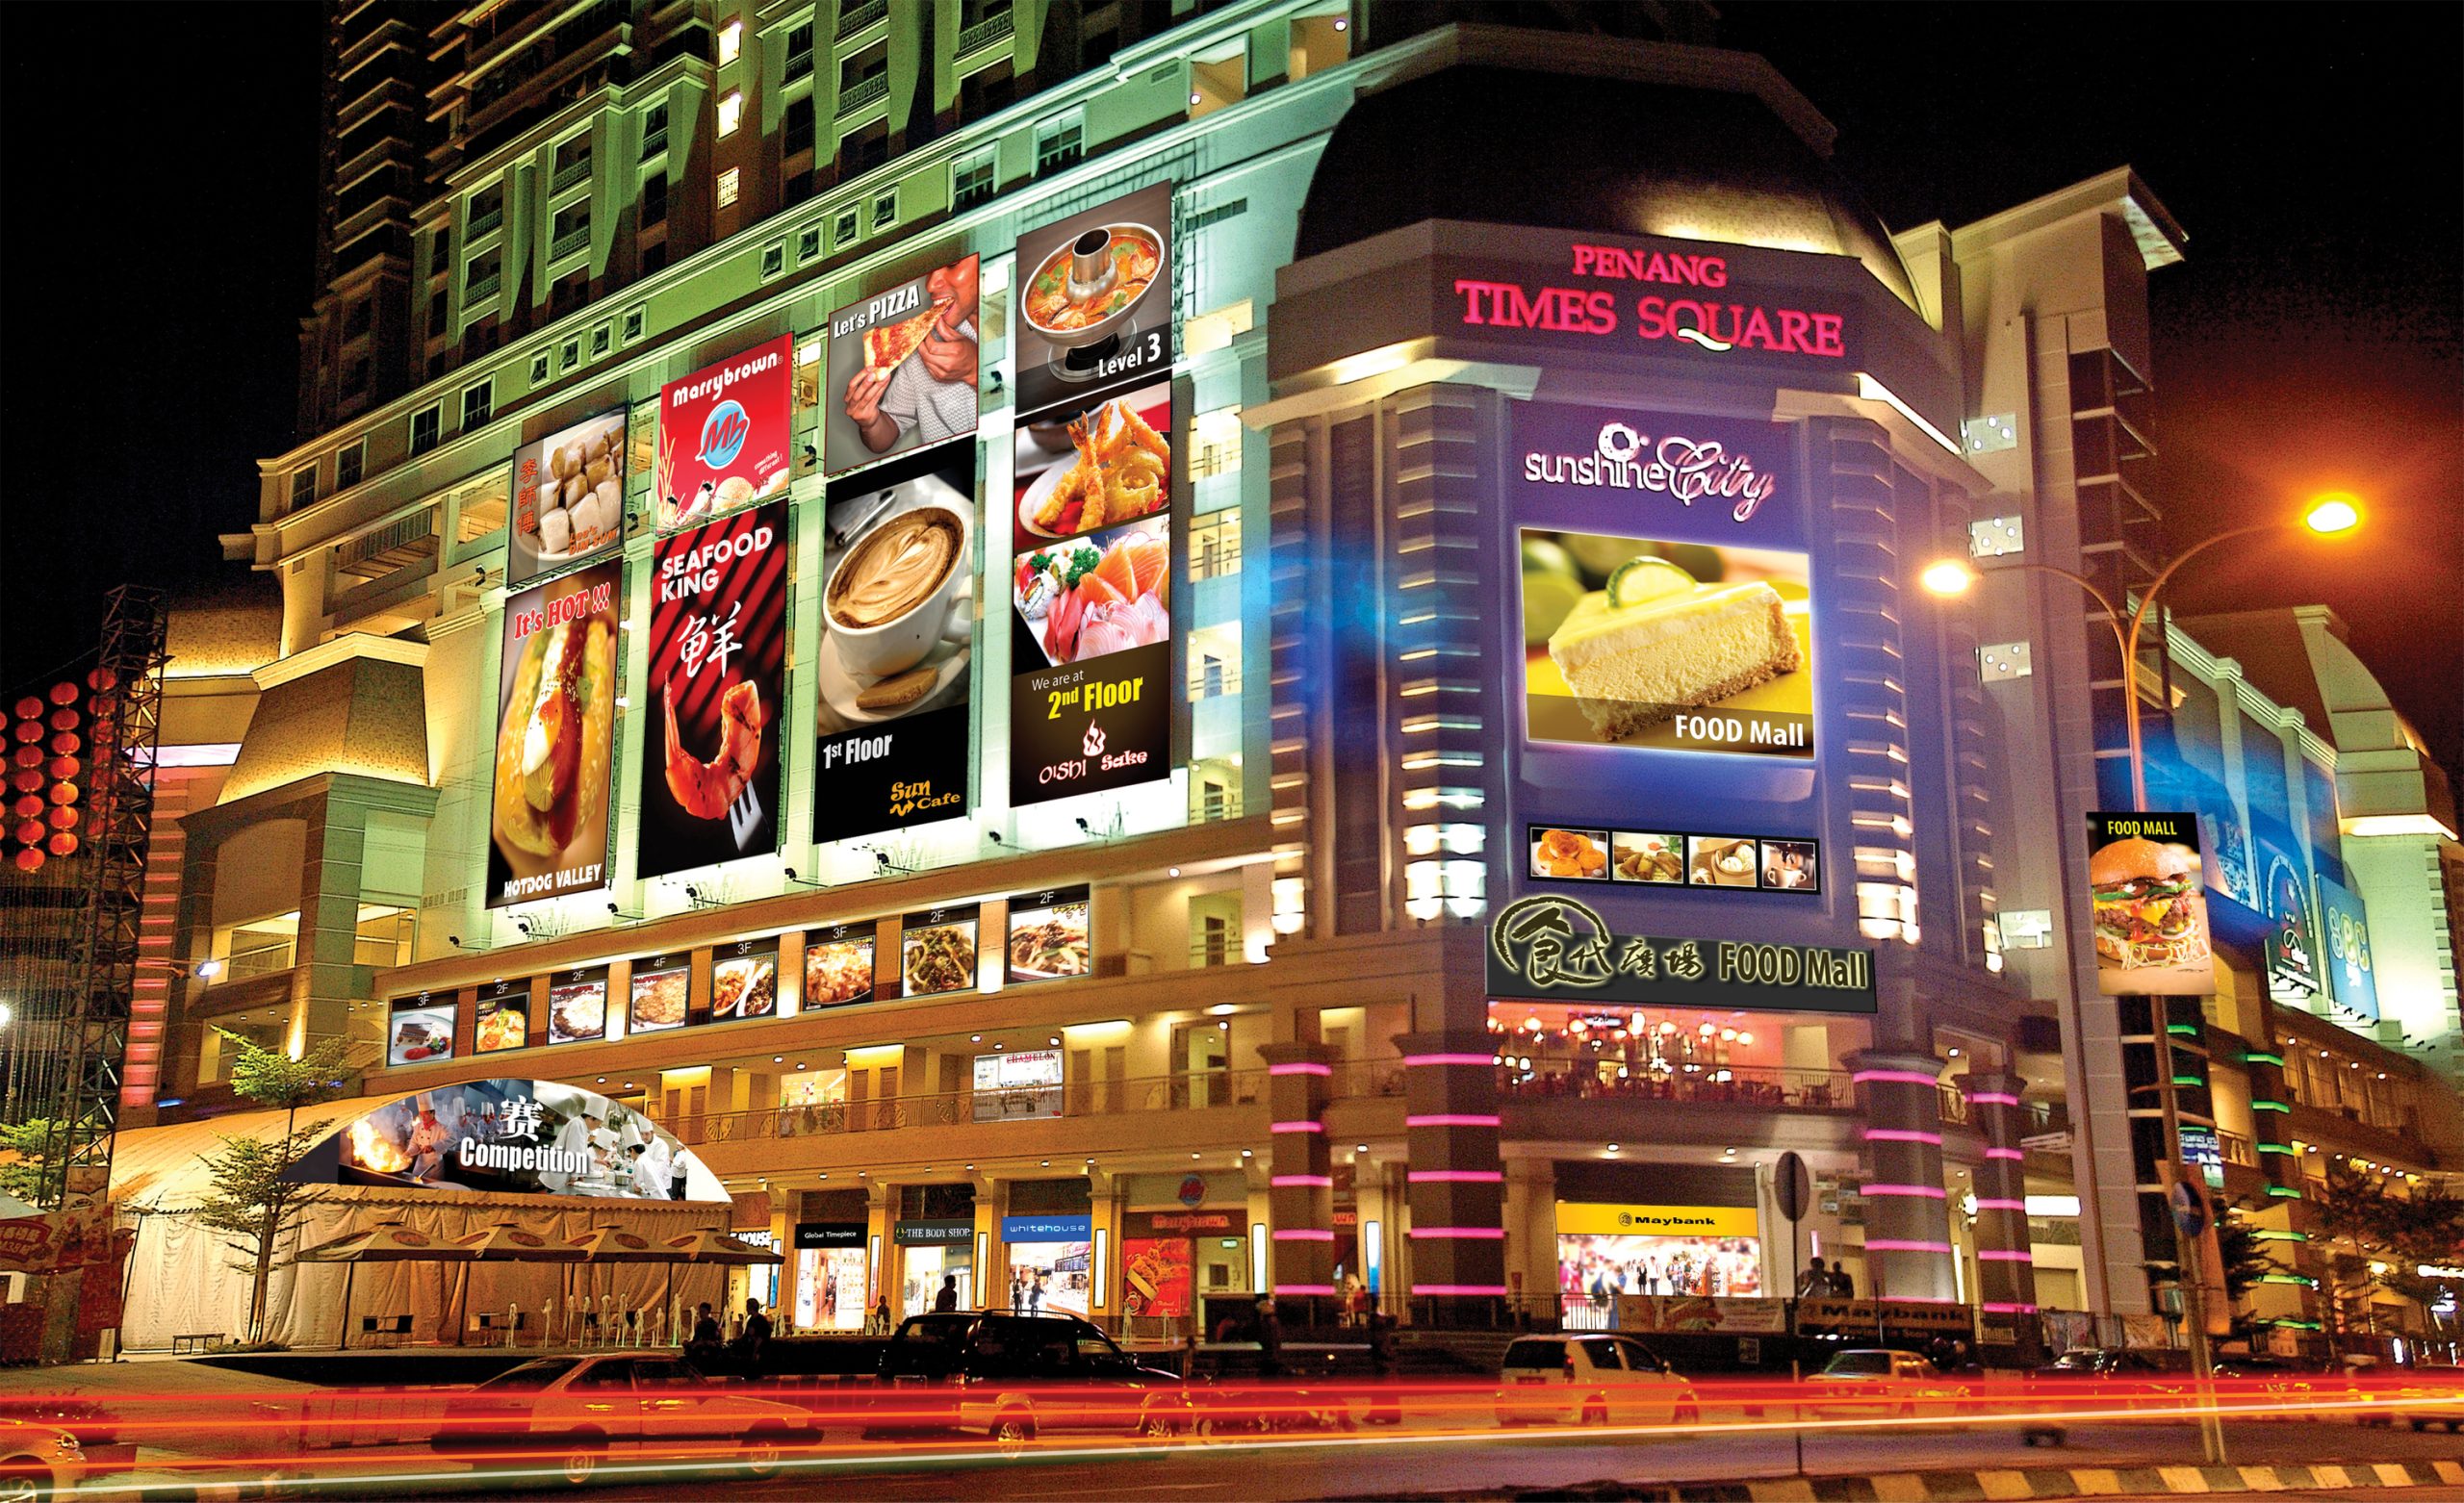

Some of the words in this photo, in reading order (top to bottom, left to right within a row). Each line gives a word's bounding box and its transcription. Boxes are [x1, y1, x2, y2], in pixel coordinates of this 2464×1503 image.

[1572, 244, 1727, 288] PENANG
[834, 312, 866, 339] Let's
[868, 285, 921, 325] PIZZA
[1454, 279, 1618, 334] TIMES
[1637, 296, 1846, 358] SQUARE
[1098, 347, 1142, 378] Level
[1146, 332, 1162, 363] 3
[1656, 436, 1773, 522] City
[569, 542, 590, 556] DIM
[593, 529, 618, 547] SUM
[661, 526, 773, 579] SEAFOOD
[661, 569, 720, 603] KING
[514, 608, 544, 640] It's
[546, 592, 589, 630] HOT
[677, 600, 743, 678] 鮮
[1032, 677, 1050, 692] We
[1052, 675, 1070, 687] are
[1072, 670, 1085, 683] at
[1047, 685, 1079, 720] 2nd
[1084, 676, 1143, 713] Floor
[1675, 715, 1743, 743] FOOD
[1750, 721, 1805, 747] Mall
[823, 742, 842, 769] 1st
[845, 733, 893, 765] Floor
[1100, 749, 1148, 771] Sake
[890, 779, 931, 802] Sun
[916, 792, 961, 810] Cafe
[2107, 821, 2141, 835] FOOD
[2143, 821, 2178, 835] MALL
[503, 870, 552, 899] HOTDOG
[555, 863, 603, 888] VALLEY
[1040, 891, 1054, 904] 2F
[930, 909, 945, 923] 2F
[833, 926, 847, 939] 3F
[737, 941, 753, 955] 3F
[654, 957, 666, 968] 4F
[1720, 944, 1799, 983] FOOD
[1807, 953, 1866, 987] Mall
[573, 970, 585, 981] 2F
[418, 995, 430, 1006] 3F
[496, 983, 509, 995] 2F
[500, 1095, 543, 1141] 赛
[461, 1135, 588, 1174] Competition
[907, 1229, 923, 1237] THE
[925, 1228, 946, 1237] BODY
[1010, 1224, 1086, 1233] whitehouse
[1635, 1216, 1715, 1227] Maybank
[826, 1231, 857, 1239] Timepiece
